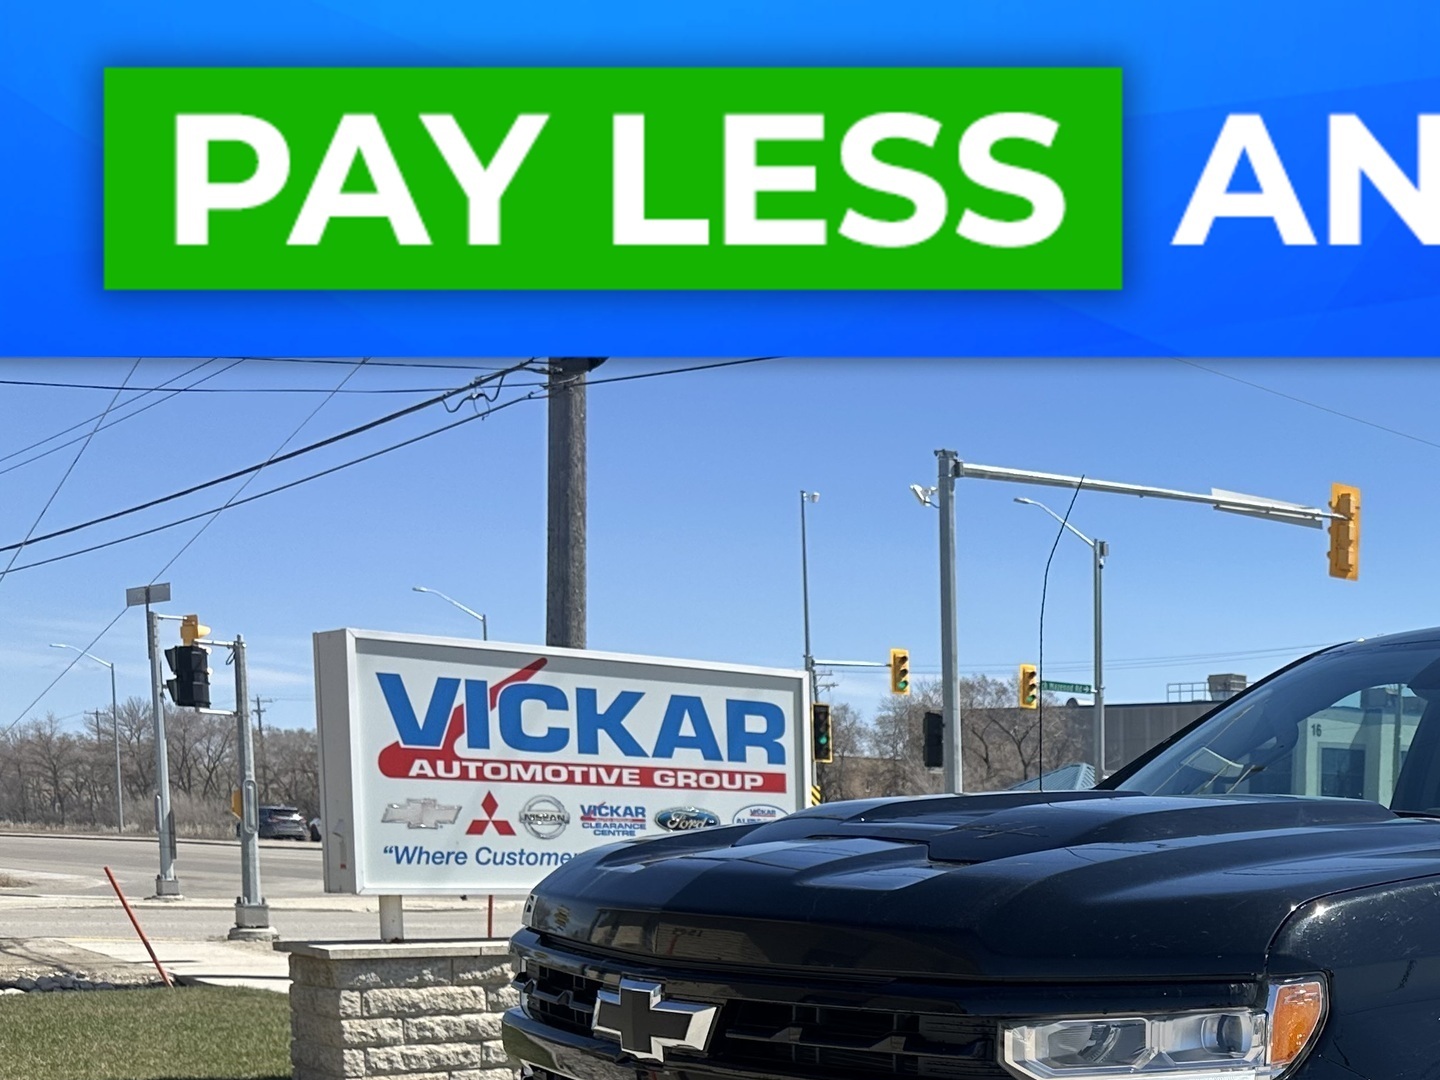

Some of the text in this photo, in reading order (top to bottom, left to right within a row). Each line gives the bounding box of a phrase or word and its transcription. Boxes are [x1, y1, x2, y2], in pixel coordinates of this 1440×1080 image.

[376, 671, 787, 765] VICKAR
[408, 759, 764, 791] AUTOMOTIVE GROUP
[524, 812, 566, 823] NISSAN
[580, 804, 647, 817] VICKAR
[582, 822, 647, 830] CLEARANCE
[667, 811, 707, 829] Ford
[593, 829, 636, 837] CENTRE
[475, 847, 578, 867] Custome
